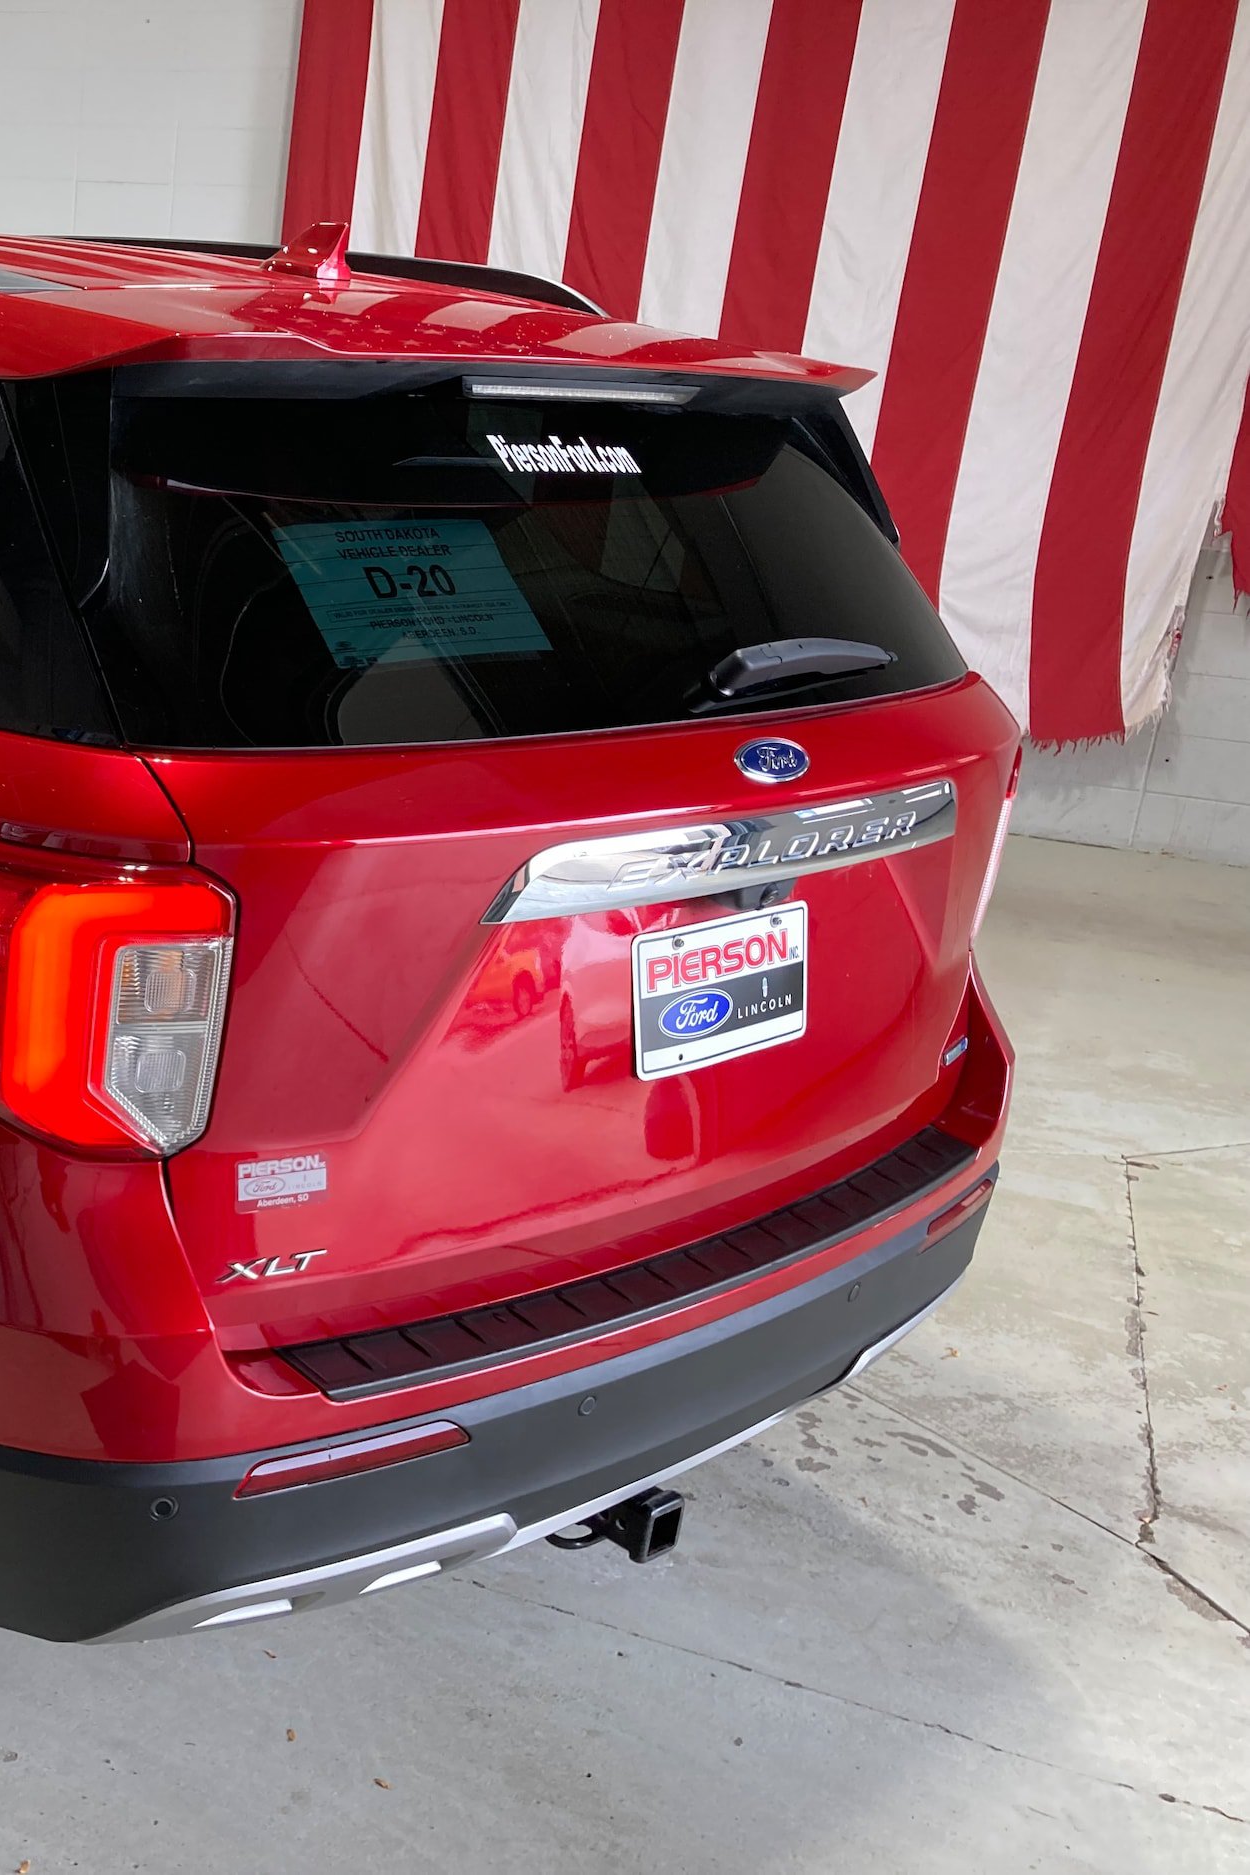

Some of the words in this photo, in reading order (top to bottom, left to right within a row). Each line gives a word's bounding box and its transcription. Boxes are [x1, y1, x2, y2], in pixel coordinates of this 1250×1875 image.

[486, 434, 642, 473] PiersonFord.com
[335, 528, 382, 543] SOUTH
[385, 527, 440, 540] DAKOTA
[336, 545, 397, 560] VEHICLE
[397, 544, 452, 557] DEALER
[363, 564, 456, 599] D-20
[370, 618, 416, 631] PIERSON
[454, 614, 494, 624] LINCOLN
[756, 746, 798, 772] Ford
[607, 810, 916, 891] EXPLORER
[646, 929, 788, 993] PIERSON
[675, 989, 719, 1032] Ford
[737, 993, 793, 1020] LINCOLN
[238, 1153, 320, 1179] PIERSON
[252, 1180, 278, 1193] Ford
[287, 1181, 323, 1191] LINCOLN
[256, 1195, 297, 1208] Aberdeen,
[297, 1193, 309, 1203] SD
[215, 1248, 328, 1284] XLT
